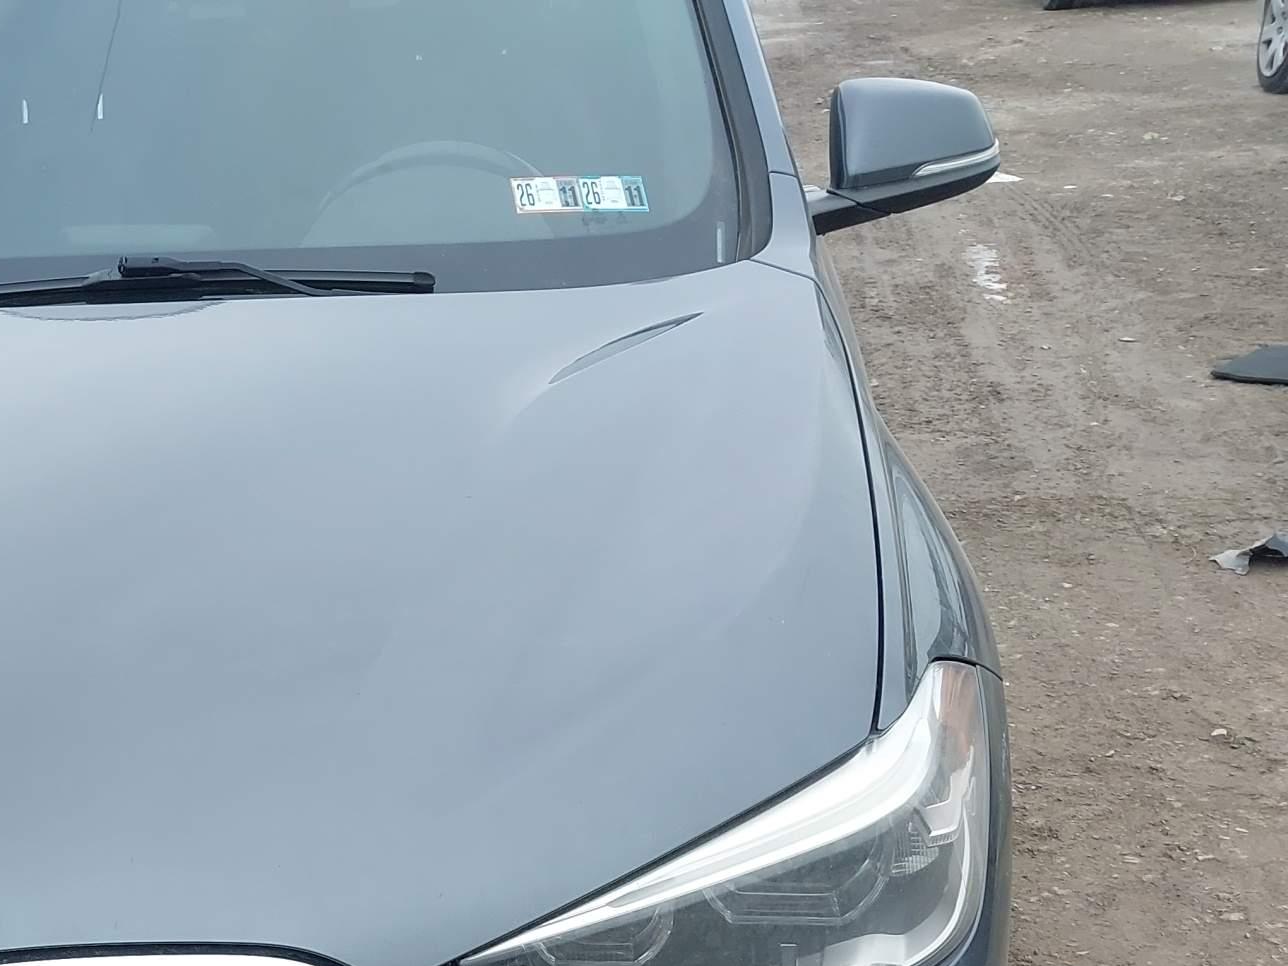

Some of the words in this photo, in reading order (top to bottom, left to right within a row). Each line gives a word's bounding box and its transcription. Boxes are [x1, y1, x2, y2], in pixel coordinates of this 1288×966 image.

[516, 183, 535, 206] 26
[559, 186, 579, 207] 11
[582, 182, 601, 205] 26
[624, 185, 647, 207] 11
